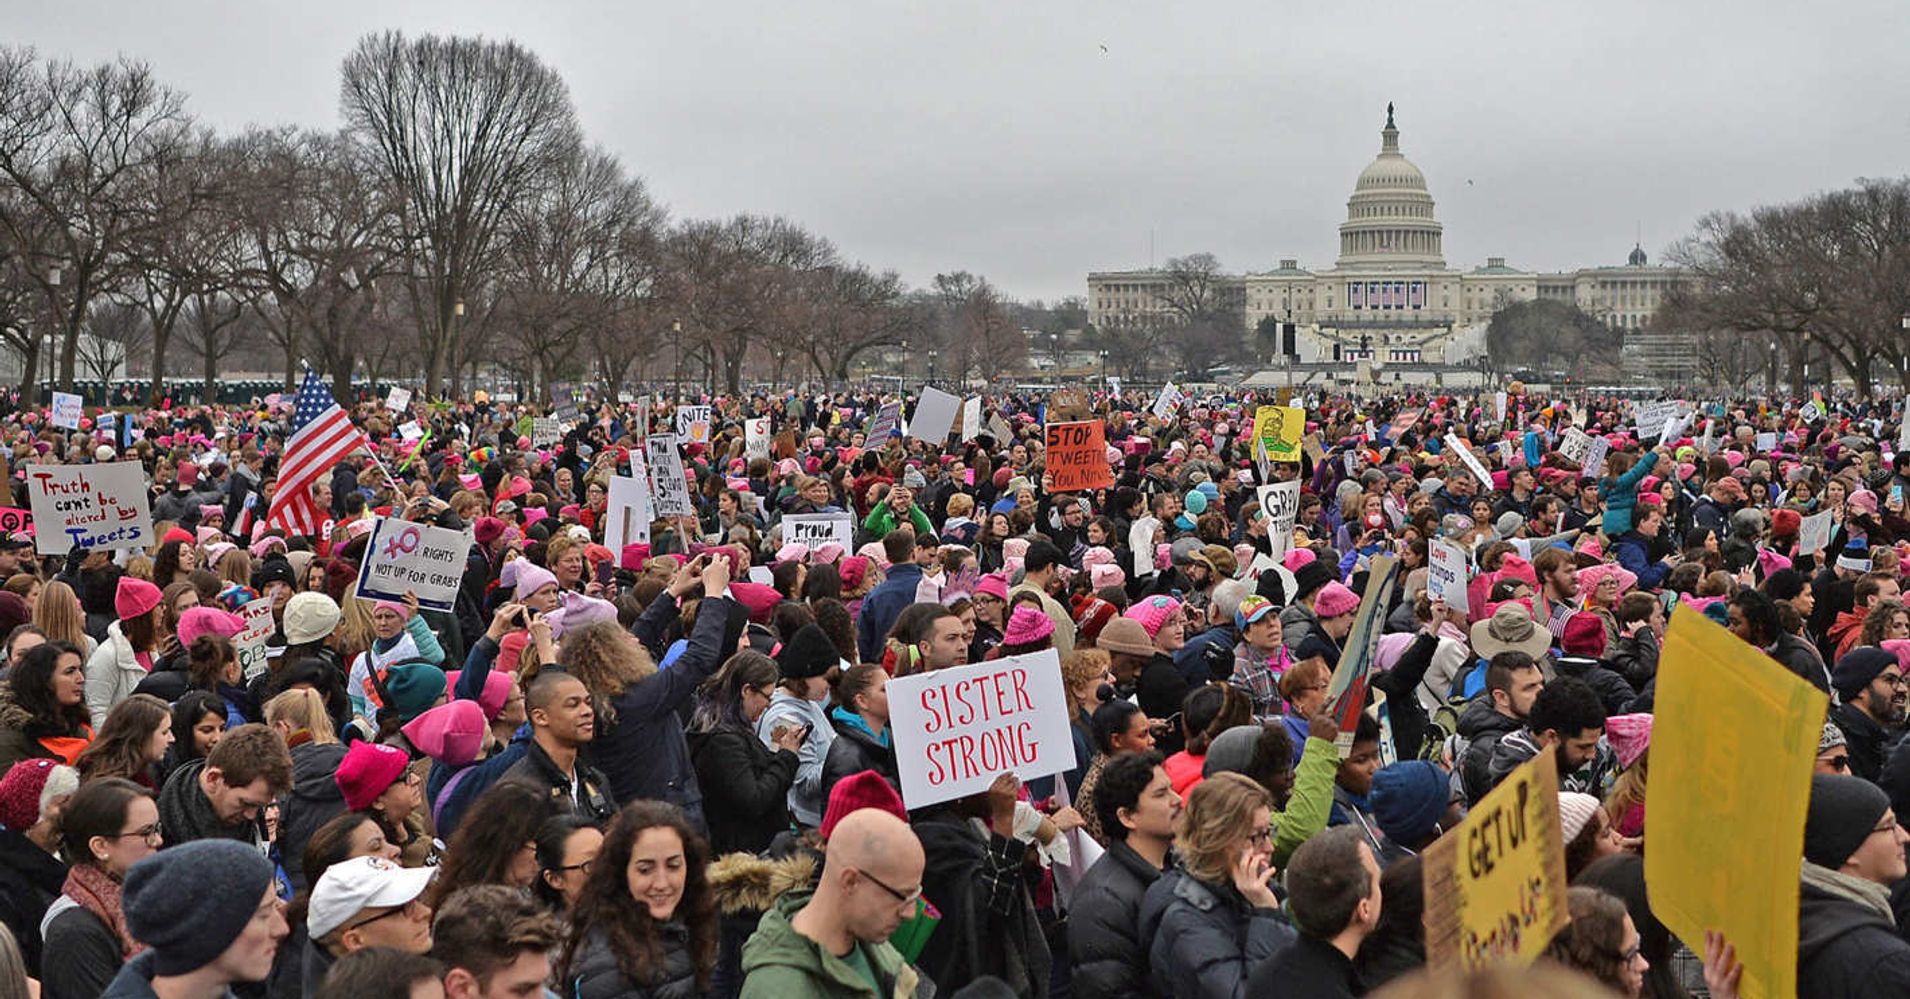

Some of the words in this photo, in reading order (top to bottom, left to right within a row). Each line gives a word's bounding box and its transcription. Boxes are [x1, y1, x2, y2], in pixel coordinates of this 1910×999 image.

[677, 407, 710, 437] UNITE
[1047, 425, 1092, 446] STOP
[32, 469, 91, 496] Truth
[97, 491, 118, 506] be
[65, 508, 106, 526] altered
[117, 506, 138, 521] by
[65, 526, 142, 548] Tweets
[795, 520, 834, 538] Proud
[422, 546, 455, 562] RIGHTS
[374, 562, 393, 577] NOT
[394, 565, 407, 578] UP
[407, 570, 427, 584] FOR
[430, 573, 460, 589] GRABS
[921, 668, 1035, 734] SISTER
[926, 721, 1039, 786] STRONG
[1468, 807, 1502, 881] GET
[1506, 780, 1529, 850] UP
